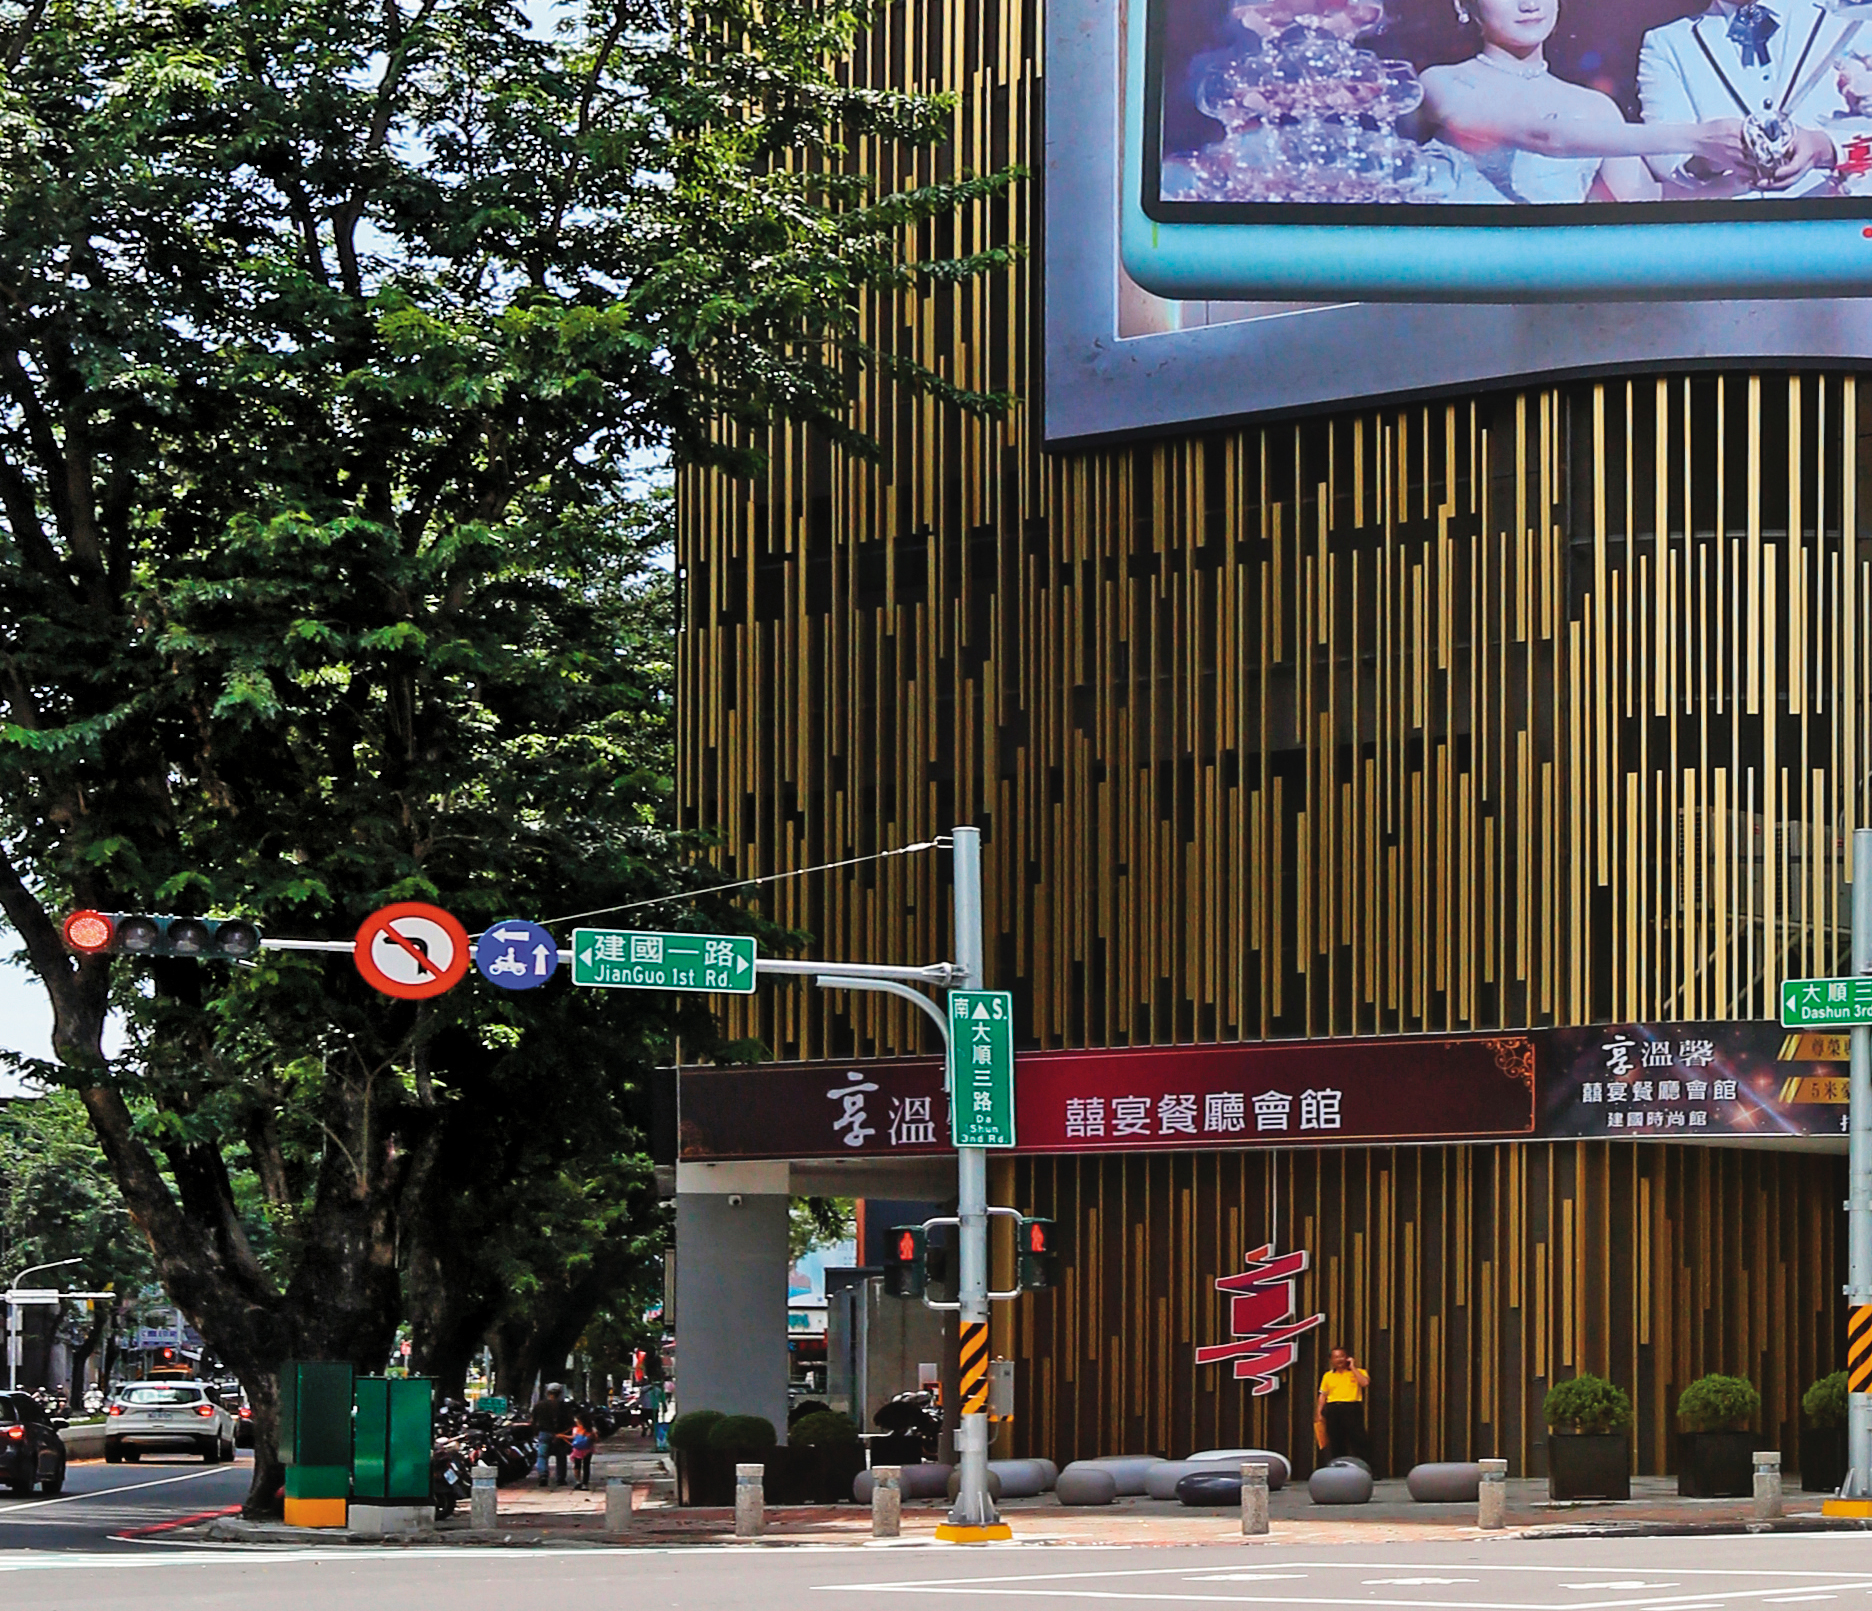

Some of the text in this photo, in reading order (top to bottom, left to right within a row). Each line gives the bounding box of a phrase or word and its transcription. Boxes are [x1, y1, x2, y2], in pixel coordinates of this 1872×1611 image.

[594, 934, 736, 969] 建國一路
[594, 964, 733, 988] JianGuo 1st Rd.
[953, 997, 970, 1019] 南
[992, 997, 1008, 1020] S.
[1801, 1006, 1850, 1019] Dashun
[1602, 1034, 1714, 1075] 享溫馨
[971, 1021, 993, 1112] 大順三路
[1582, 1079, 1737, 1103] 囍宴餐廳會館
[827, 1071, 1343, 1146] 享溫 囍宴餐廳會館
[976, 1114, 992, 1124] Da
[1607, 1111, 1708, 1128] 建國時尚館
[969, 1124, 999, 1134] Shun
